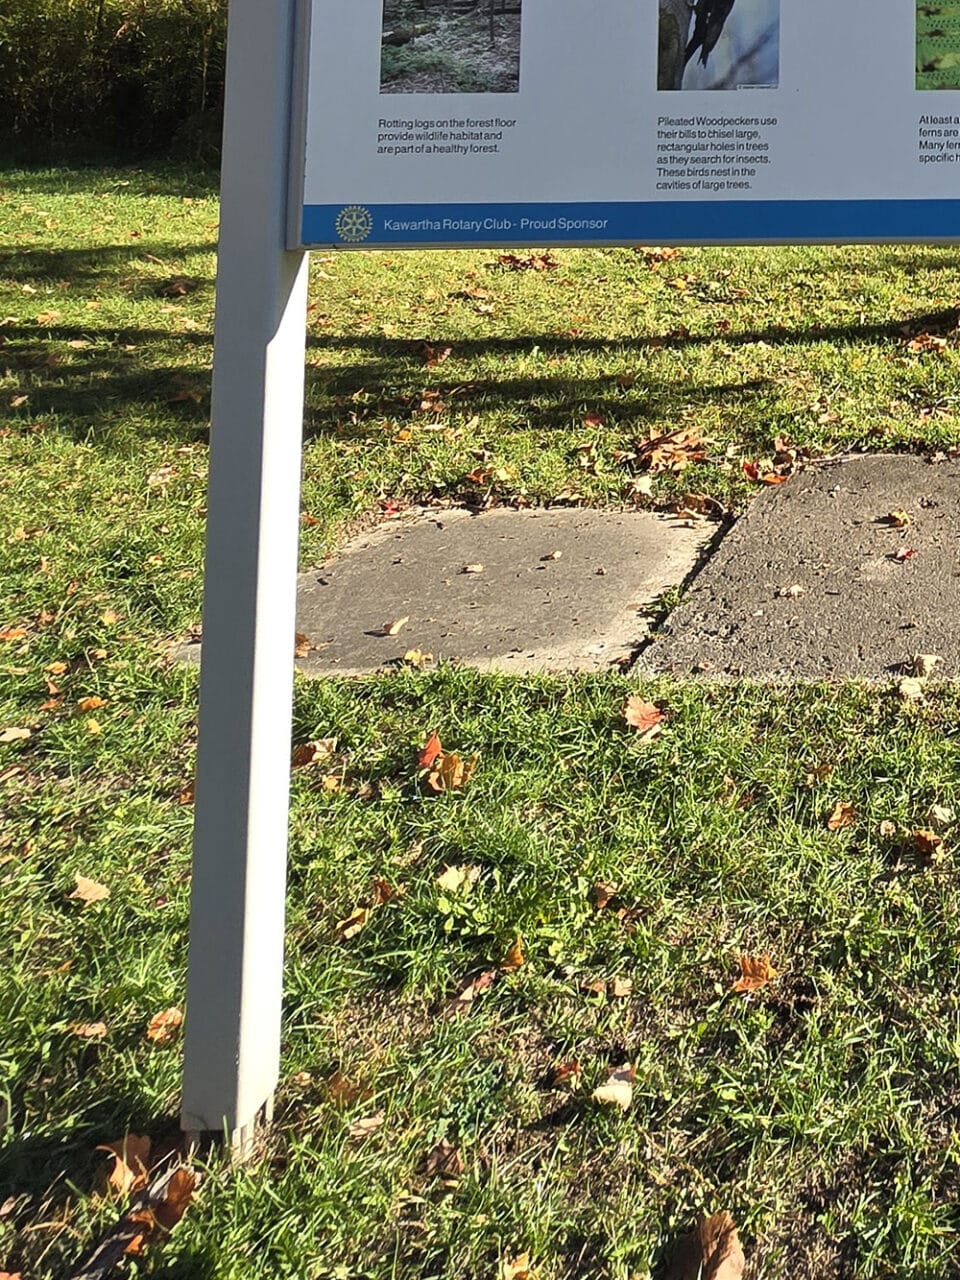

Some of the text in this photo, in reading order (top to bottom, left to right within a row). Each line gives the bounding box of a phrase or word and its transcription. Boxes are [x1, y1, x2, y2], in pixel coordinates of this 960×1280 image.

[378, 118, 413, 130] Rotting
[414, 118, 434, 130] logs
[449, 118, 464, 128] the
[466, 118, 493, 128] forest
[495, 118, 516, 127] floor
[657, 117, 777, 129] Pileated Woodpeckers use
[930, 114, 952, 124] least
[377, 131, 502, 144] provide wildlife habitat and
[657, 130, 677, 139] their
[678, 130, 696, 139] bills
[707, 129, 734, 139] chisel
[735, 129, 760, 141] large,
[919, 127, 942, 137] ferns
[943, 129, 958, 137] are
[377, 146, 393, 154] are
[394, 145, 413, 156] part
[433, 144, 468, 156] healthy
[469, 144, 499, 153] forest.
[919, 140, 944, 152] Many
[919, 153, 954, 165] specific
[384, 219, 440, 231] Kawartha
[442, 219, 481, 233] Rotary
[483, 218, 511, 230] Club
[520, 218, 556, 230] Proud
[557, 218, 607, 232] Sponsor
